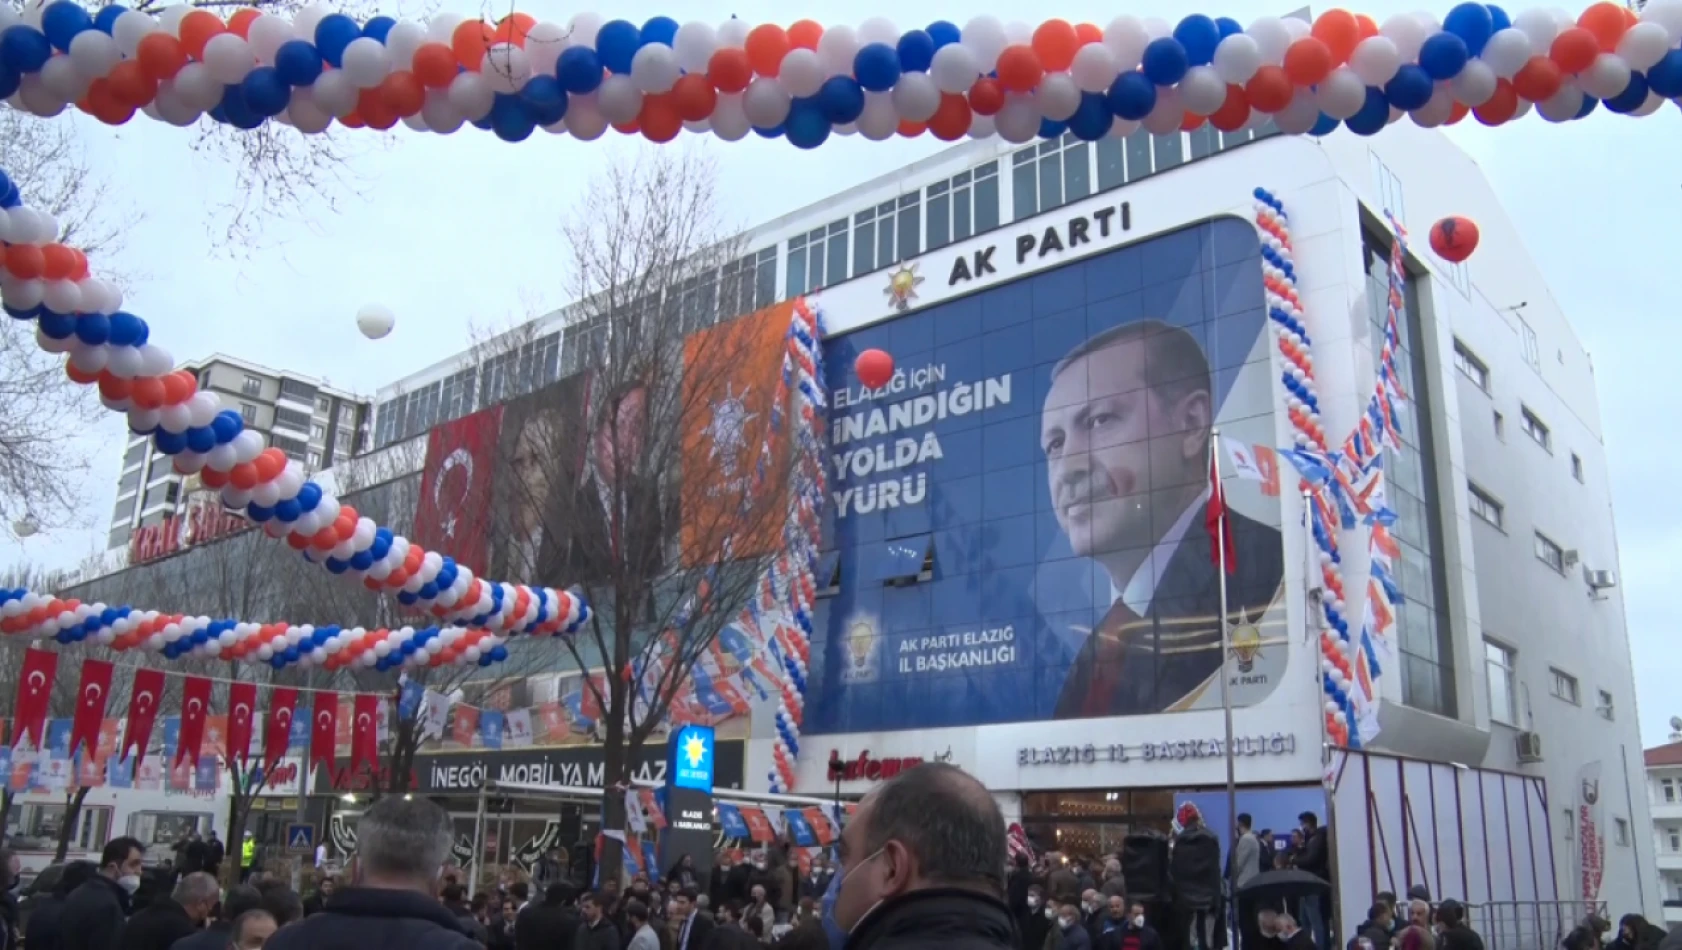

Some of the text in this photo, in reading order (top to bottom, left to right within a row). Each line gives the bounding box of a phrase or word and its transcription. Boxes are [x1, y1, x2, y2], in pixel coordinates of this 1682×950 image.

[949, 246, 997, 286] AK
[833, 373, 1011, 445] İNANDIĞIN
[832, 431, 943, 480] YOLDA
[832, 472, 926, 518] YÜRÜ
[899, 639, 918, 653] AK
[916, 645, 1016, 672] BAŞKANLIĞI
[499, 754, 582, 787] MOBİLYA
